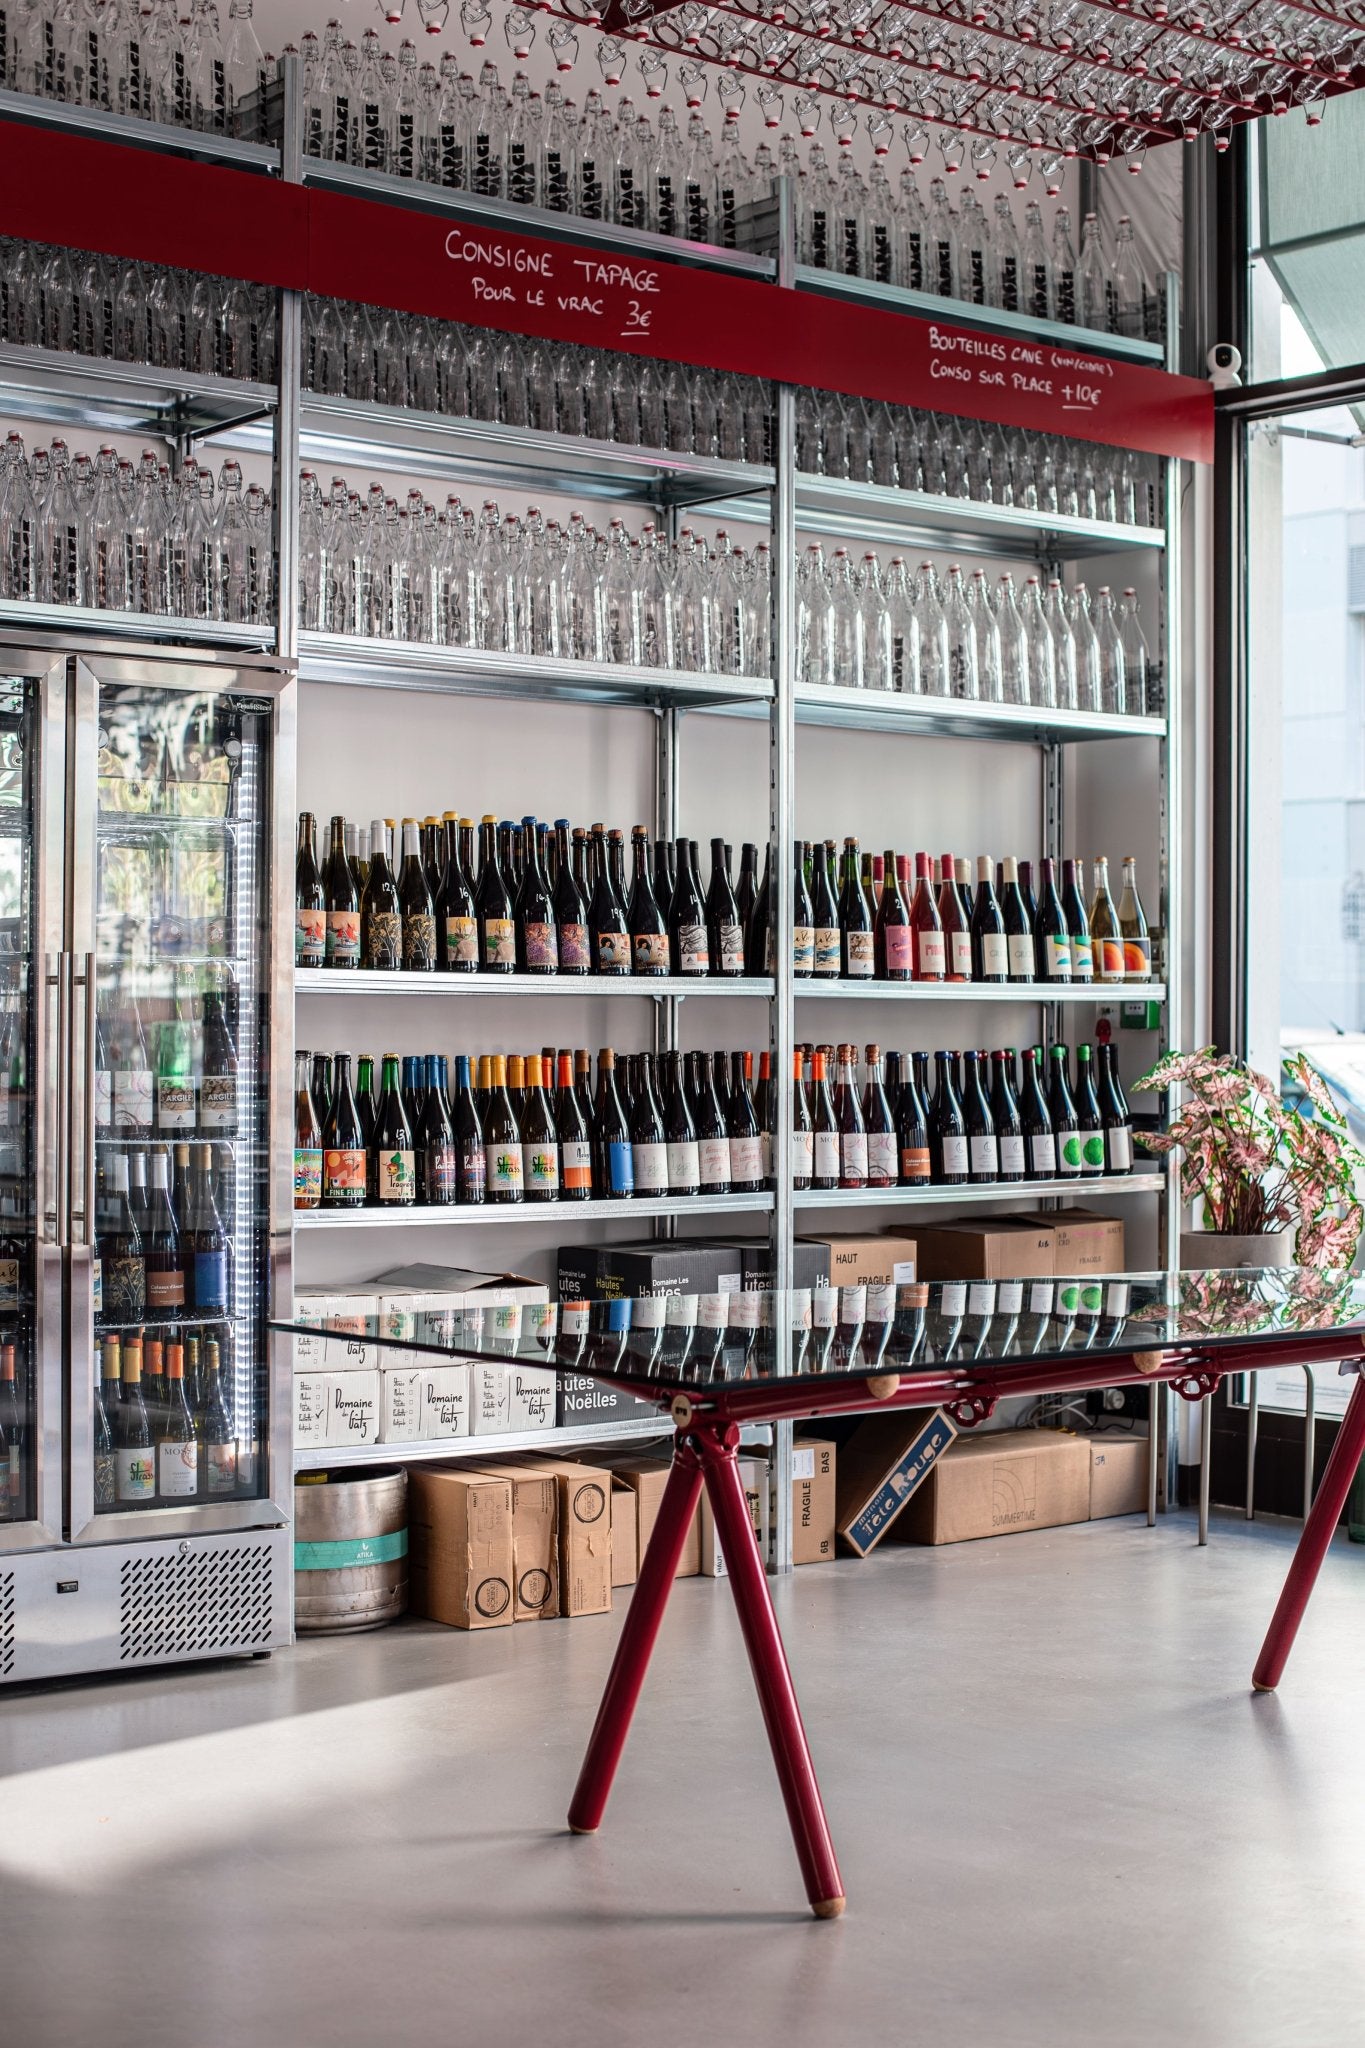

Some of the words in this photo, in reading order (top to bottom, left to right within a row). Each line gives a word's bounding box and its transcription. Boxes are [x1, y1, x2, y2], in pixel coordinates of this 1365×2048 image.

[89, 31, 98, 100] TAPAGE
[214, 60, 224, 128] TAPAGE
[365, 103, 379, 168] TAPAGE
[400, 114, 413, 177] TAPAGE
[619, 168, 633, 227] TAPAGE
[722, 189, 736, 248] TAPAGE
[445, 229, 554, 277] CONSIGNE
[573, 259, 660, 292] TAPAGE
[471, 277, 516, 301] POUR
[526, 289, 545, 306] LE
[557, 296, 604, 315] VRAC
[626, 301, 652, 327] 3€
[929, 326, 1006, 361] BOUTEILLES
[1011, 347, 1044, 365] CAVE
[930, 359, 972, 381] CONSO
[979, 370, 1006, 386] SUR
[1011, 373, 1053, 394] PLACE
[1061, 384, 1102, 405] +10€
[166, 1094, 193, 1102] ARGILE
[207, 1092, 235, 1101] ARGILE
[532, 1156, 555, 1173] Strass
[836, 1254, 858, 1264] HAUT
[559, 1269, 577, 1277] Domaine
[578, 1271, 587, 1279] Les
[596, 1278, 620, 1290] Hautes
[652, 1279, 677, 1287] Domaine
[858, 1275, 892, 1287] FRAGILE
[428, 1383, 463, 1404] Domaine
[516, 1376, 551, 1396] Domaine
[335, 1388, 373, 1409] Domaine
[564, 1391, 617, 1412] Noëlles
[130, 1462, 154, 1482] Strass
[821, 1451, 830, 1473] BAS
[888, 1433, 942, 1499] Rouge
[802, 1481, 811, 1527] FRAGILE
[857, 1489, 886, 1526] manoir
[861, 1497, 895, 1537] Tête
[992, 1509, 1036, 1527] SUMMERTIME
[357, 1551, 374, 1559] ATIKA
[820, 1539, 829, 1554] 6B
